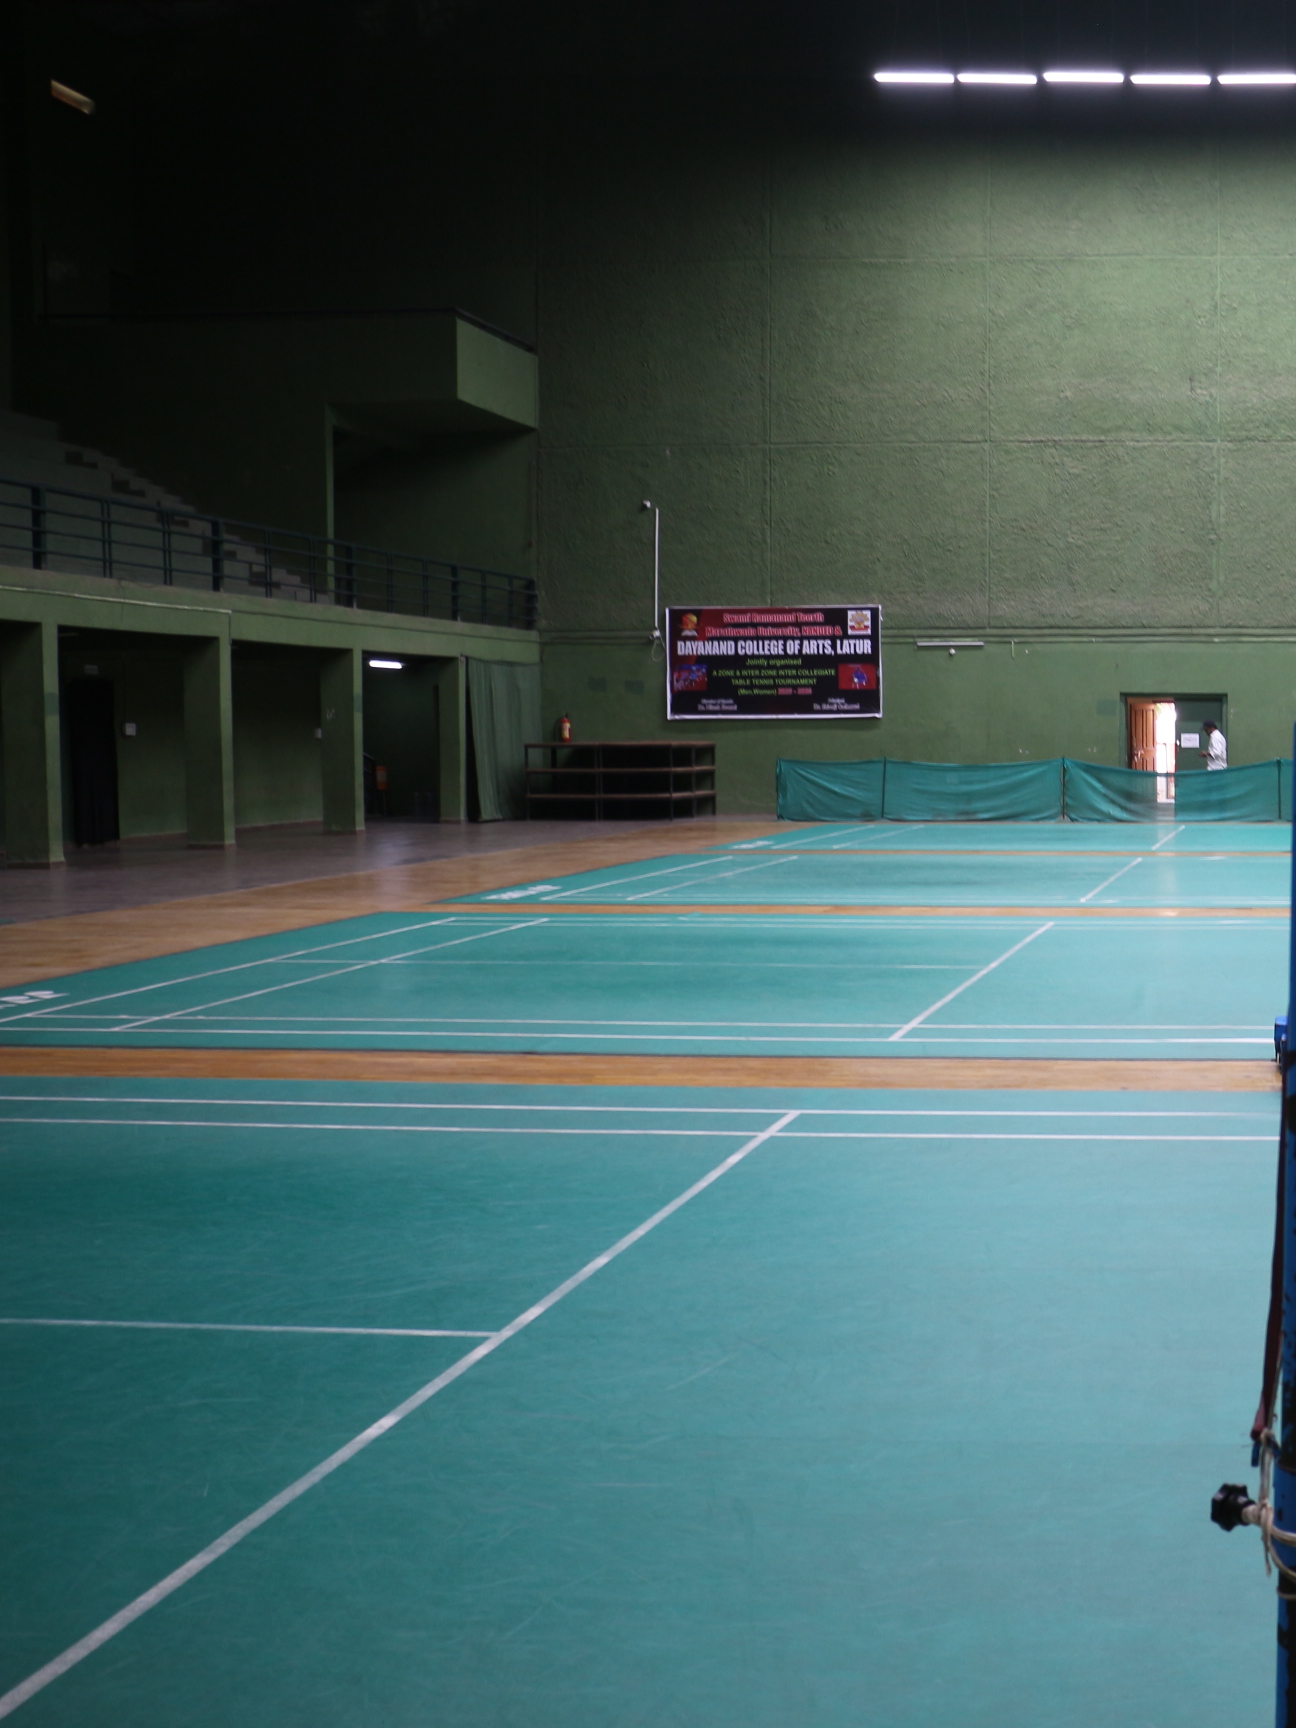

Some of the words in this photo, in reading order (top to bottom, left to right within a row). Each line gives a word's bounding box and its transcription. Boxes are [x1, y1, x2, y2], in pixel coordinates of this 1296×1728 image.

[677, 640, 735, 656] DAYANAND
[737, 640, 784, 656] COLLEGE
[786, 639, 800, 655] OF
[802, 639, 835, 656] ARTS,
[837, 639, 872, 655] LATUR
[745, 658, 768, 666] Jointly
[769, 658, 802, 666] organised
[712, 669, 718, 677] A
[718, 669, 735, 677] ZONE
[736, 669, 741, 677] &
[742, 669, 760, 677] INTER
[761, 669, 778, 677] ZONE
[778, 669, 797, 677] INTER
[731, 678, 750, 686] TABLE
[752, 678, 774, 686] TENNIS
[775, 678, 817, 686] TOURNAMENT
